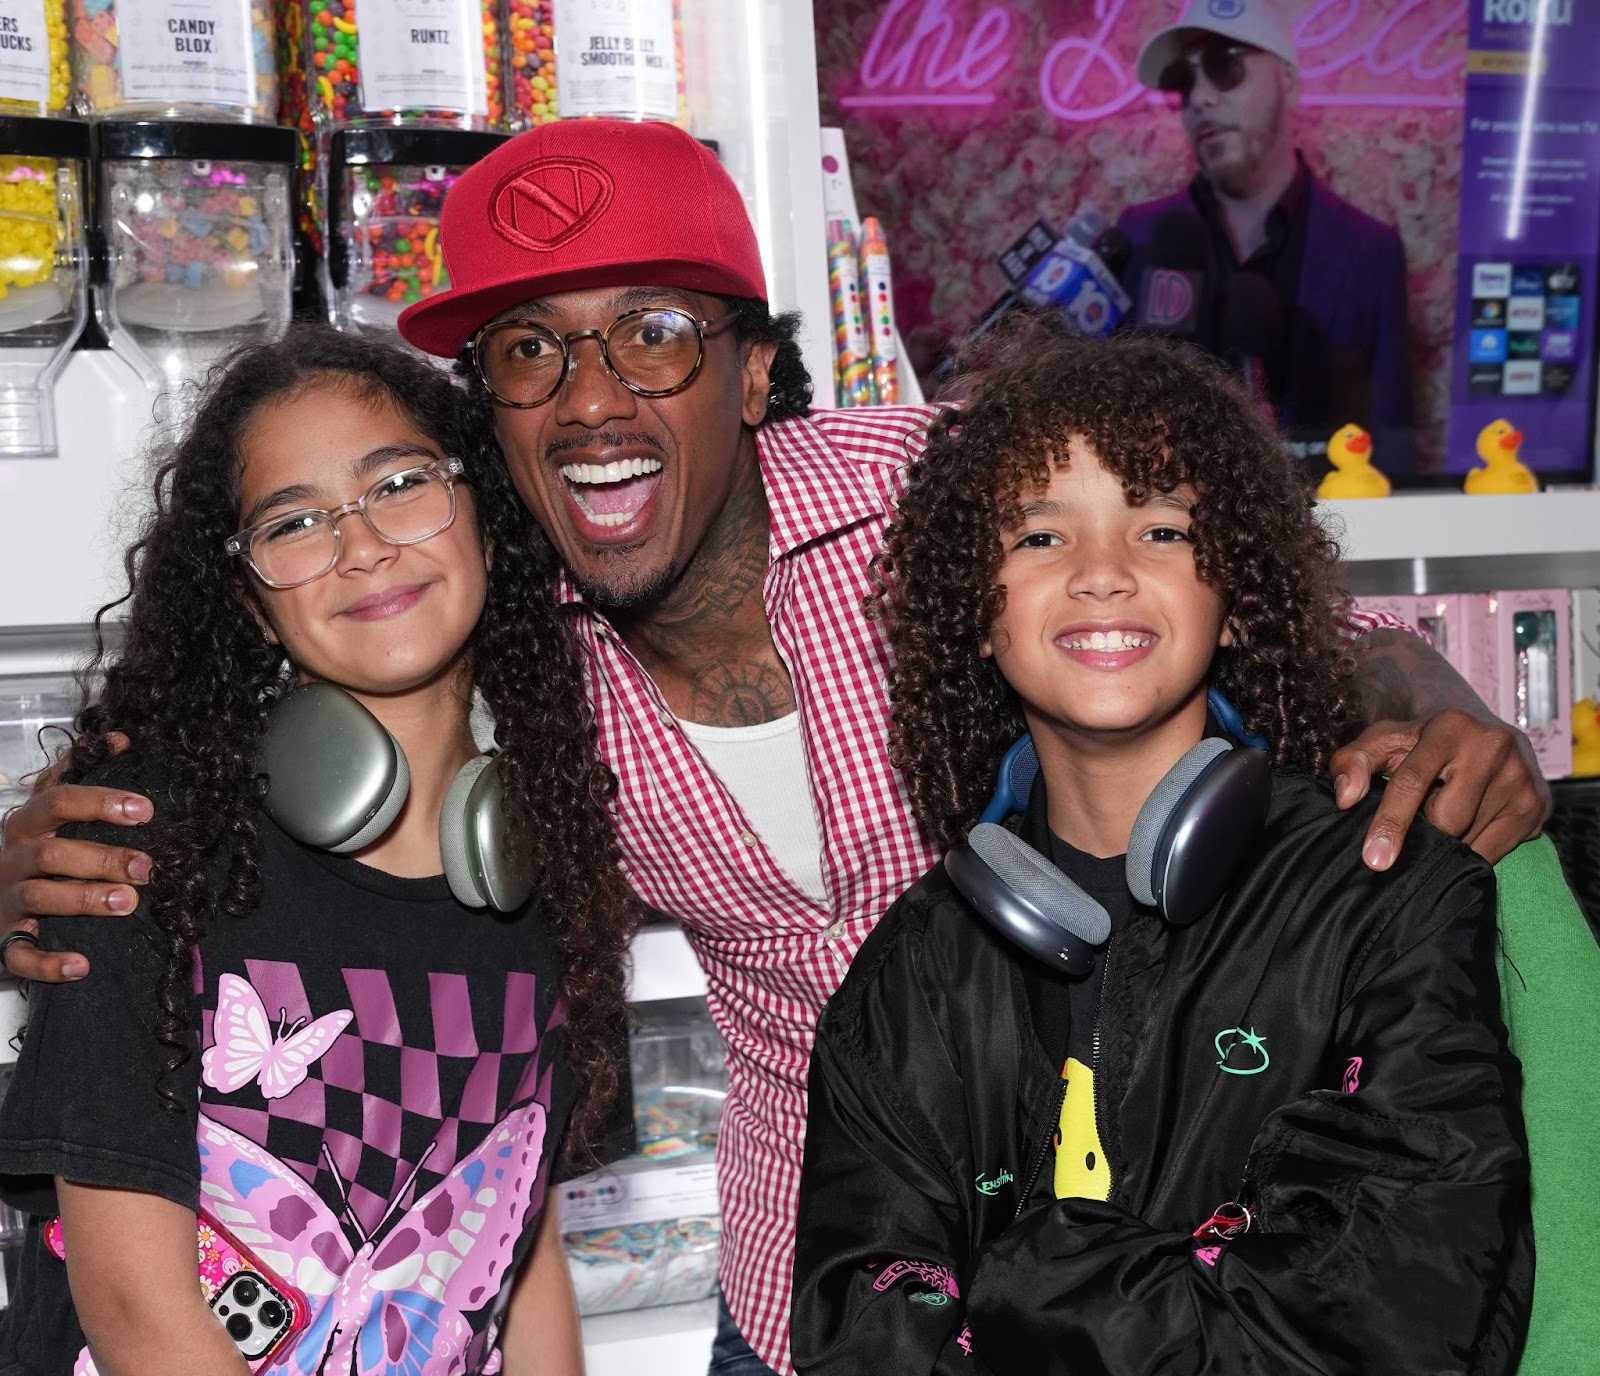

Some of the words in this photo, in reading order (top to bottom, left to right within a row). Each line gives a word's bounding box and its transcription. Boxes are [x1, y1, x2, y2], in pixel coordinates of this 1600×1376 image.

[168, 19, 215, 35] CANDY
[0, 34, 32, 51] UCKS
[411, 29, 449, 44] RUNTZ
[589, 36, 620, 50] JELLY
[624, 37, 655, 52] BLLY
[175, 38, 212, 53] BLOX
[581, 52, 637, 66] SMOOTHI
